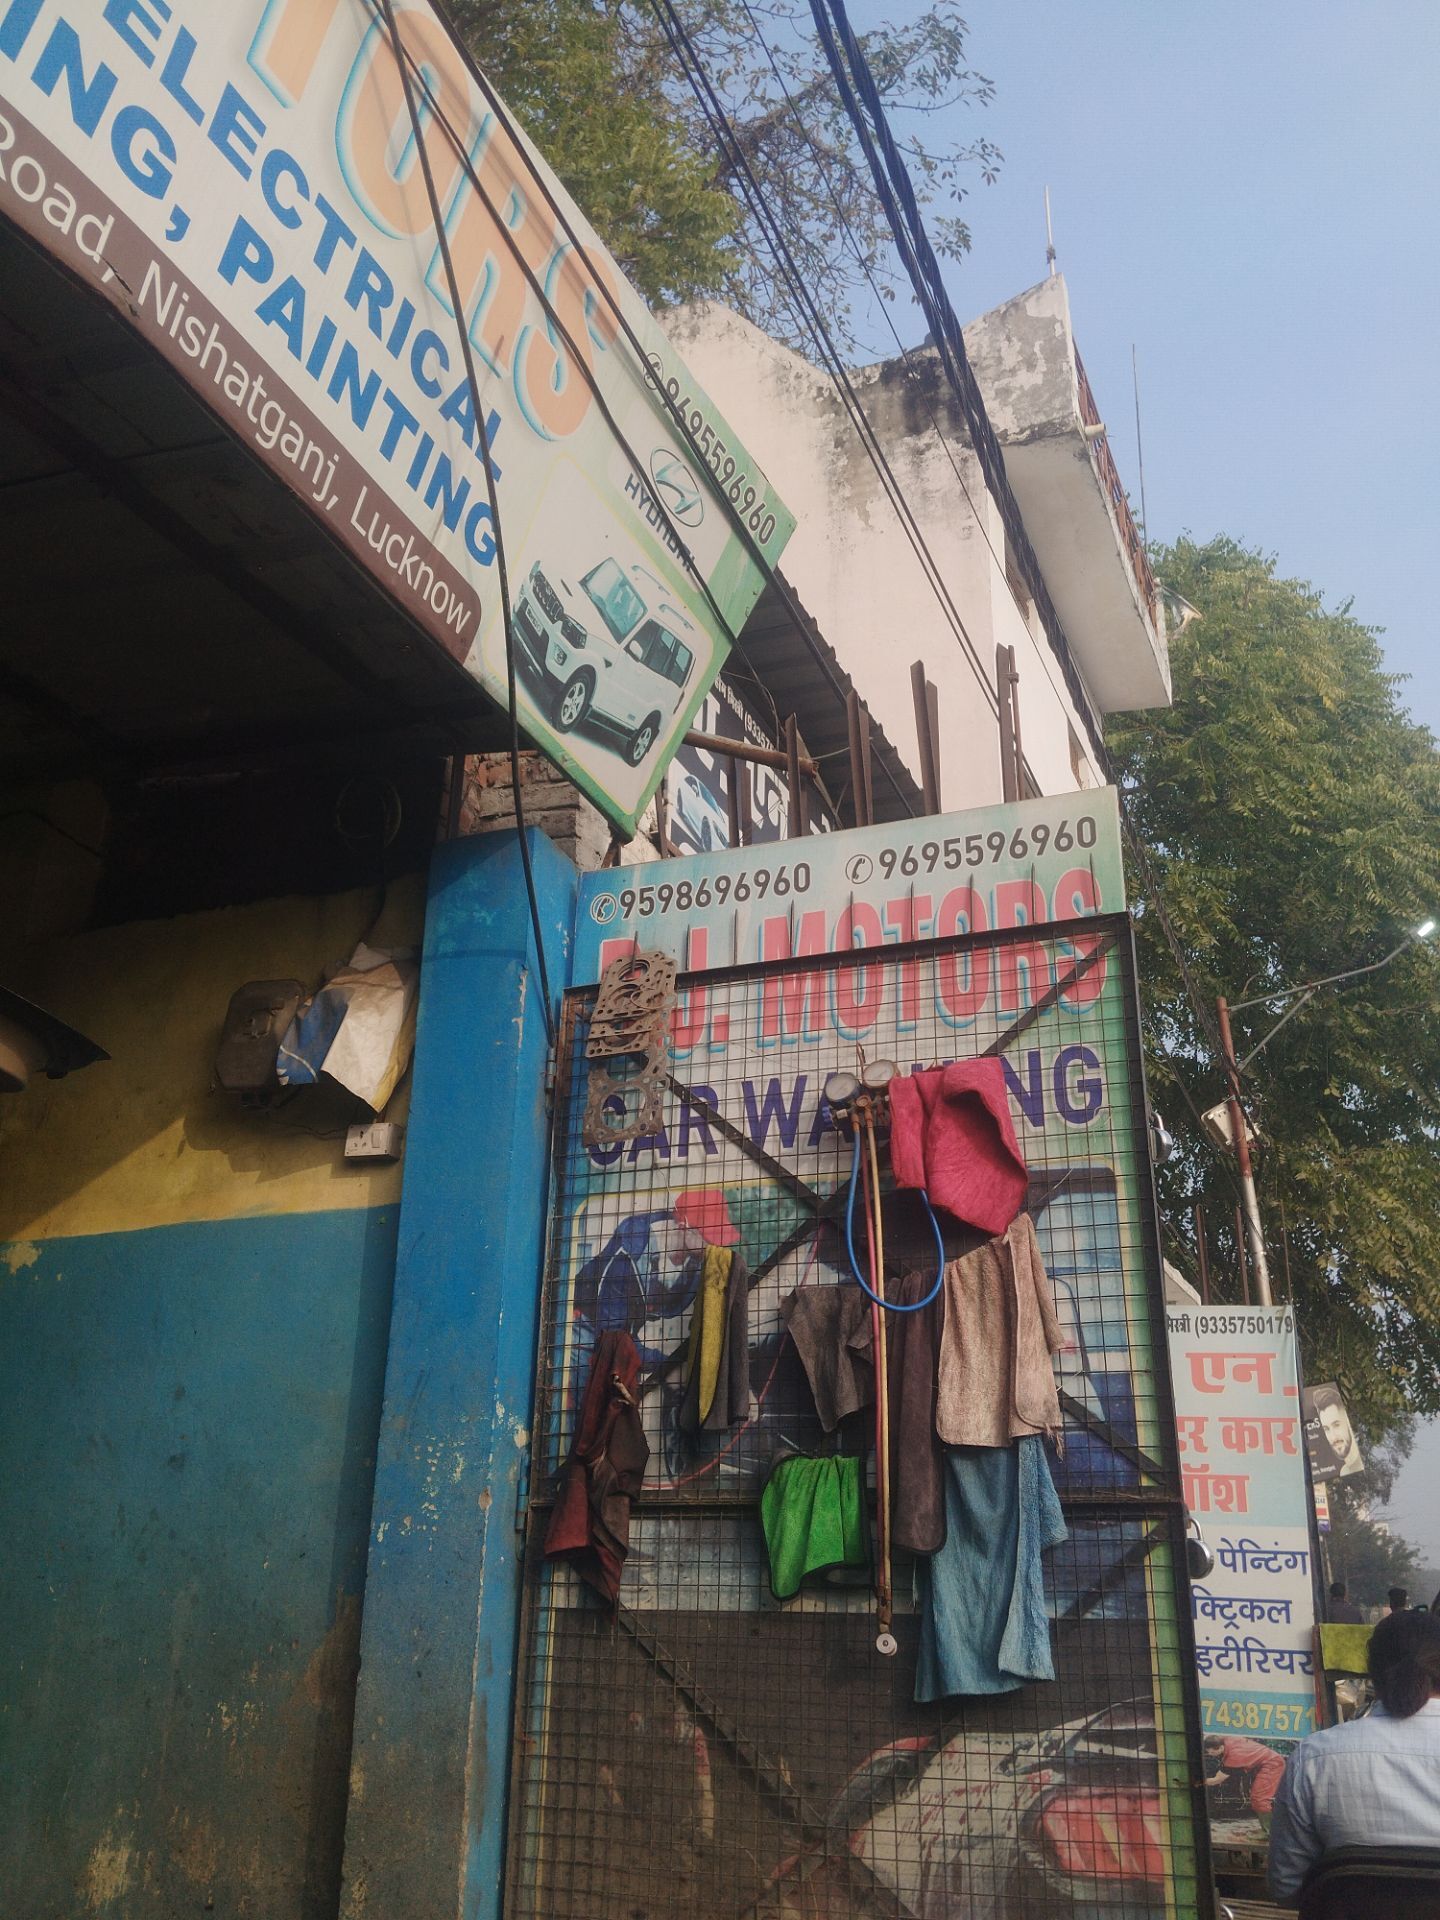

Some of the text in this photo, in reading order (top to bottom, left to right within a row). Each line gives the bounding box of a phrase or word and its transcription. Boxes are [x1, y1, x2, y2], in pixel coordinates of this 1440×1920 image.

[137, 260, 340, 508] Nishatganj,
[349, 487, 471, 634] Lucknow
[217, 214, 498, 567] PAINTING
[619, 815, 1098, 920] 9598696960 9695596960
[757, 867, 1107, 1044] MOTORS
[741, 1045, 1104, 1150] WANG
[1218, 1417, 1297, 1454] कार
